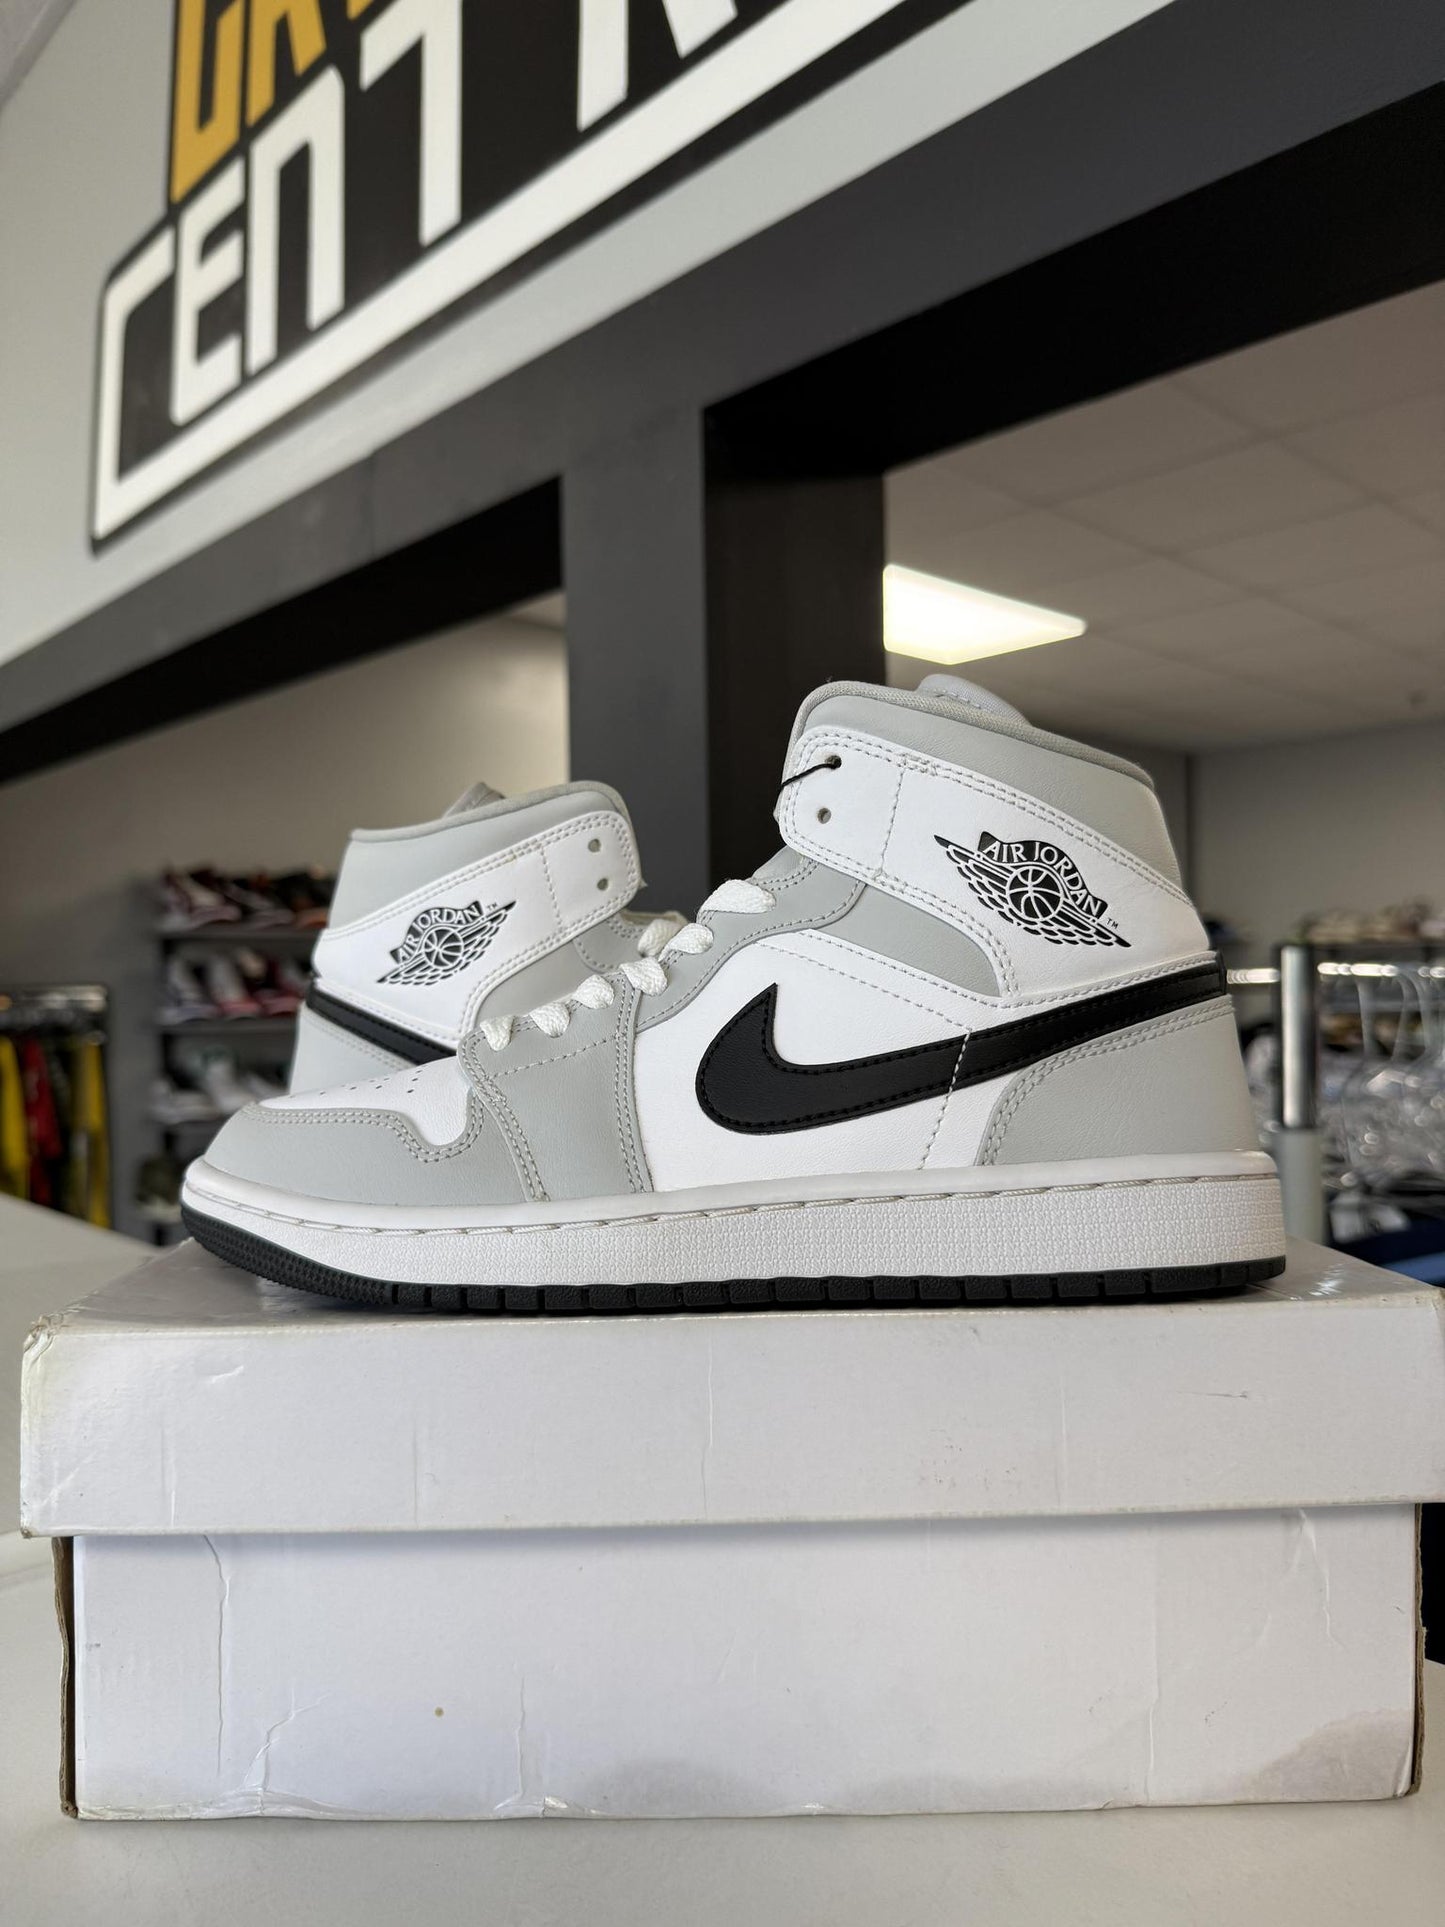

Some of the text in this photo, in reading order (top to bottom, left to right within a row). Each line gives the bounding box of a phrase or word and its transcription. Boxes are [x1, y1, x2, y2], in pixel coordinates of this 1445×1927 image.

[983, 840, 1028, 863] AIR
[1033, 841, 1101, 918] JORDAN
[398, 933, 420, 964] AIR
[412, 904, 481, 934] JORDAN
